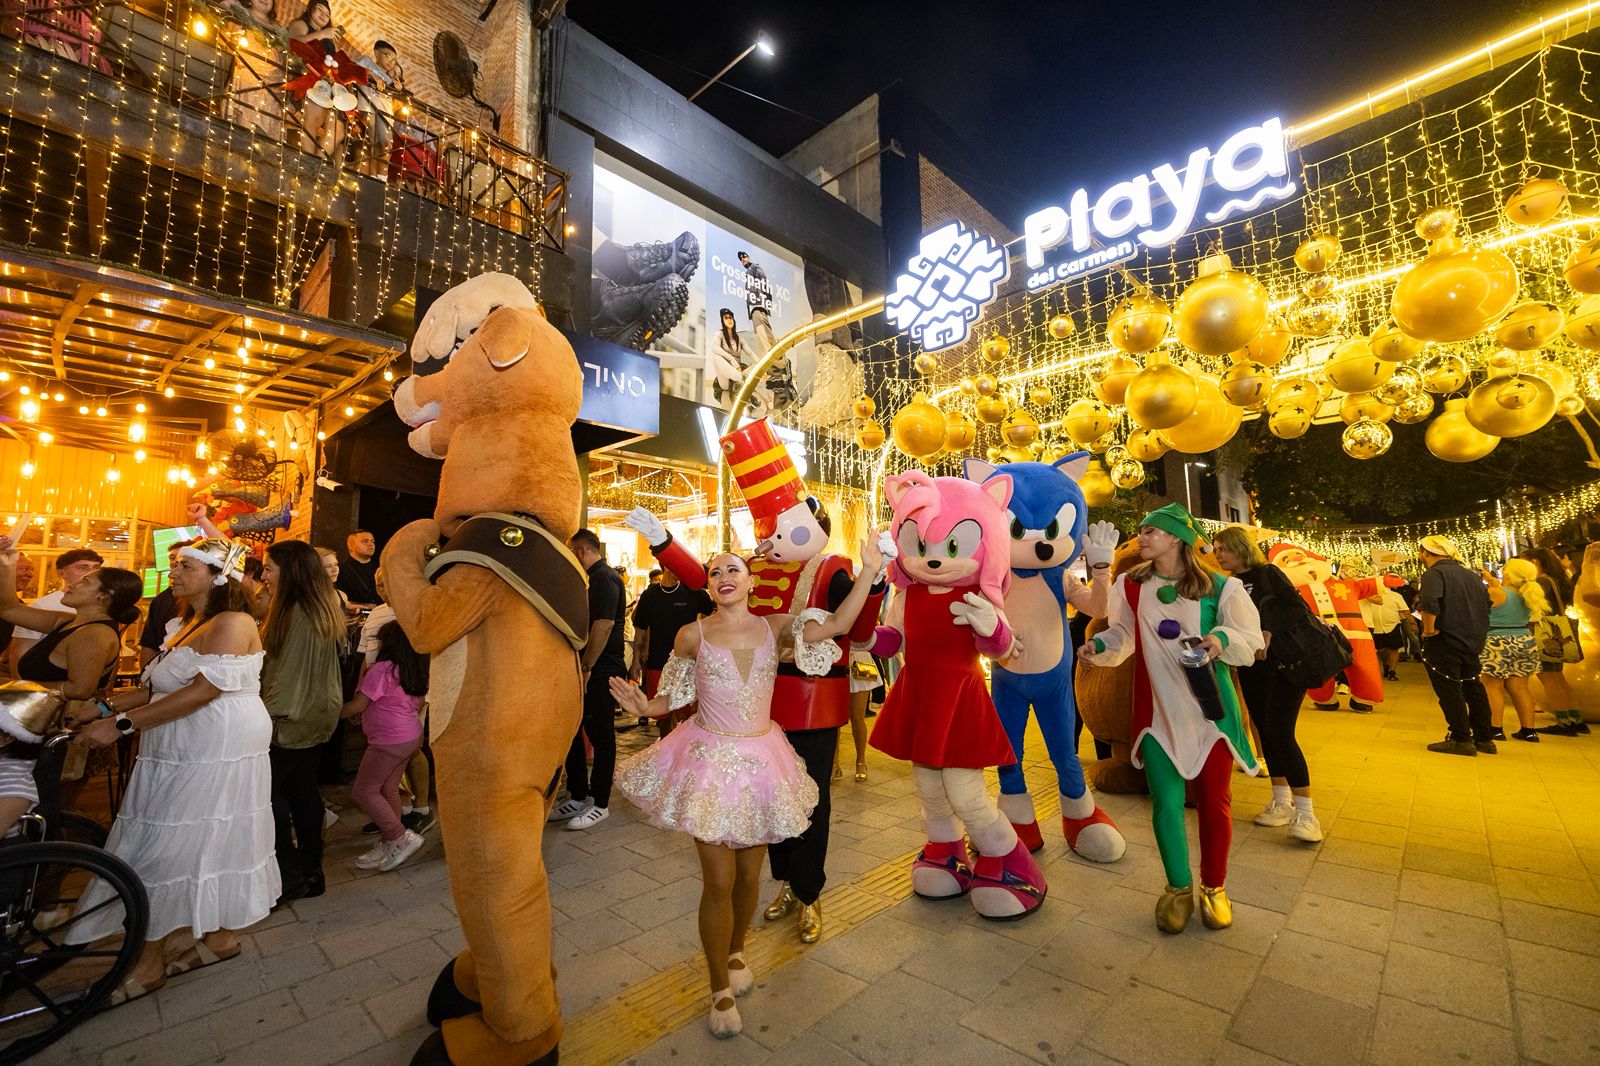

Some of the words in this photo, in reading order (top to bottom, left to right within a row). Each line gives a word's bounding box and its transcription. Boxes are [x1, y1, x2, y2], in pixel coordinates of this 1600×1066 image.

[1024, 117, 1287, 269] Playa
[711, 255, 773, 295] Crosspath
[775, 284, 790, 302] XC
[1027, 268, 1055, 289] del
[581, 361, 646, 397] TINO
